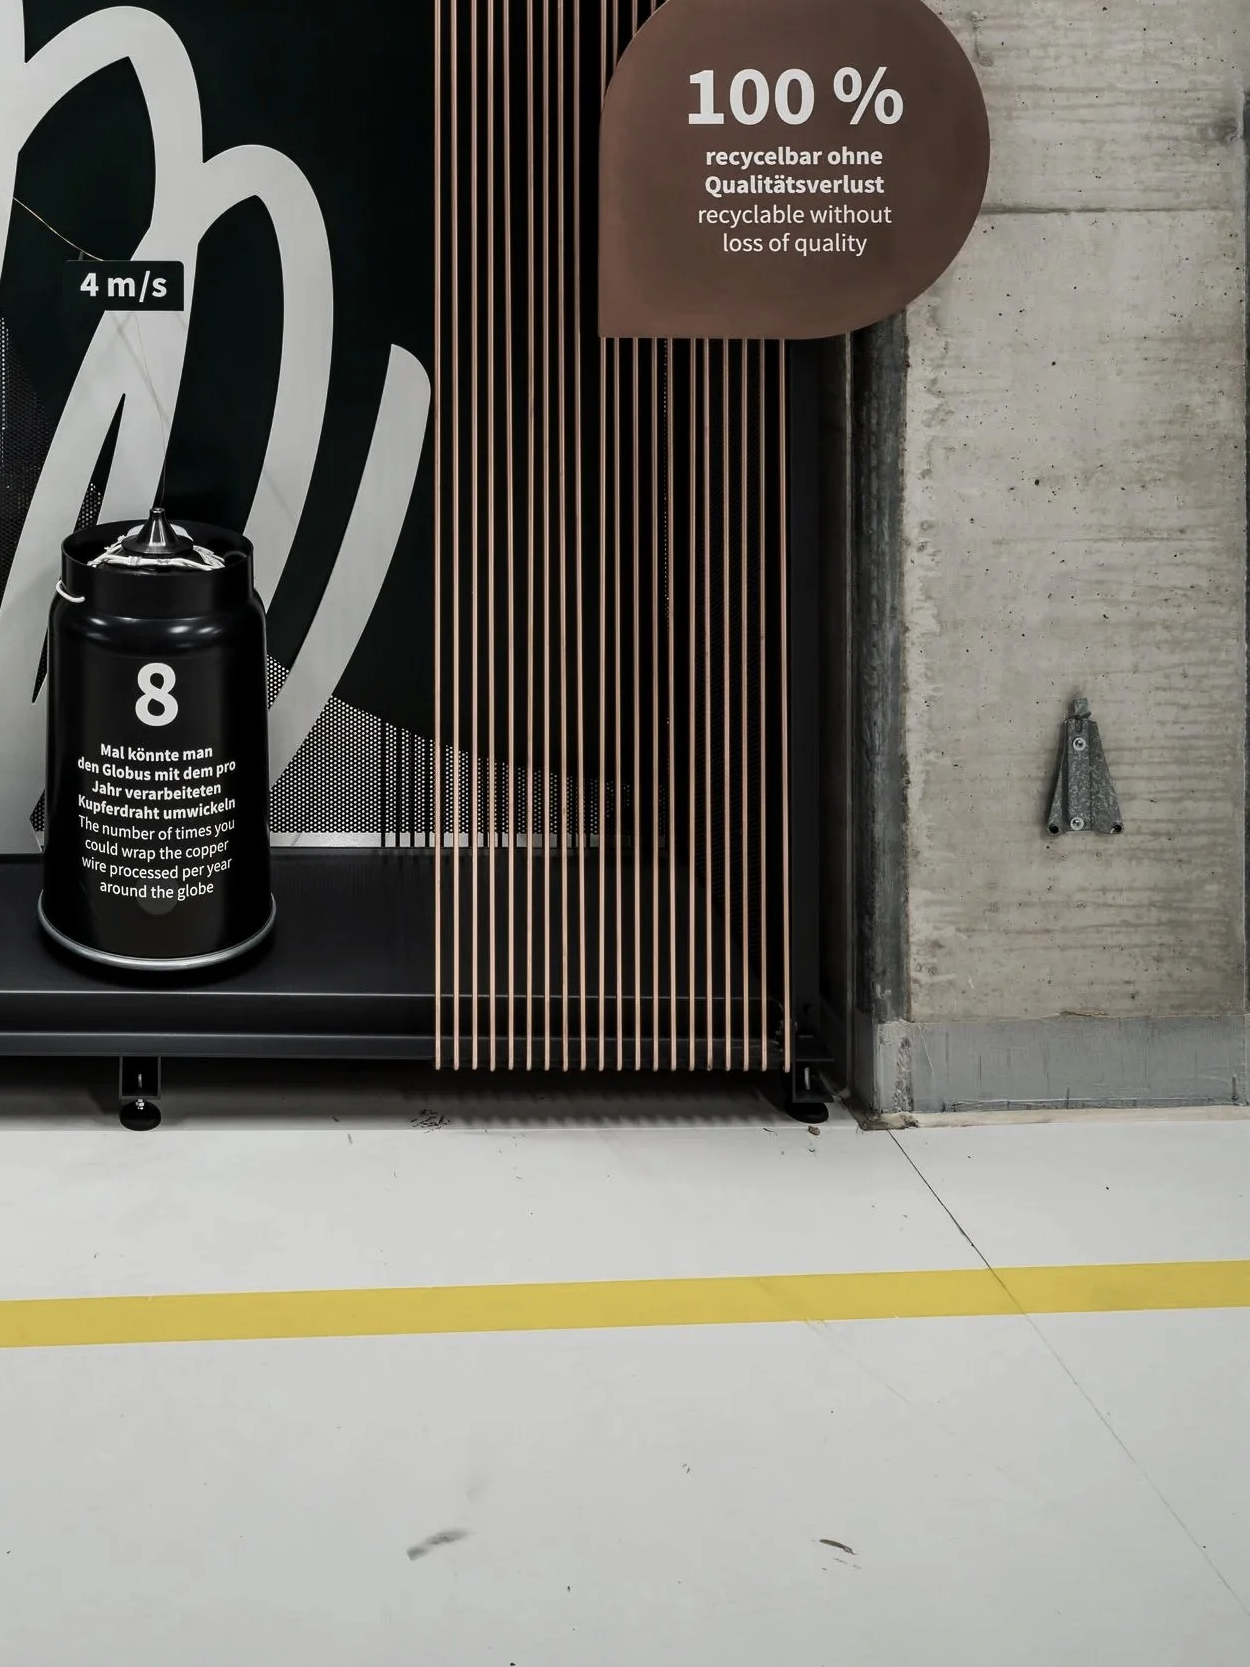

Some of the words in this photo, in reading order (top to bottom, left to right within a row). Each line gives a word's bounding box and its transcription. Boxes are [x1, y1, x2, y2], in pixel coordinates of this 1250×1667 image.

[688, 68, 815, 126] 100
[833, 66, 904, 125] %
[706, 146, 823, 171] recycelbar
[827, 146, 883, 166] ohne
[704, 175, 885, 199] Qualitätsverlust
[698, 204, 805, 229] recyclable
[809, 204, 892, 224] without
[723, 233, 764, 253] loss
[768, 233, 791, 253] of
[794, 233, 868, 257] quality
[80, 272, 100, 297] 4
[107, 270, 167, 303] m/s
[134, 662, 179, 727] 8
[100, 743, 125, 760] Mal
[128, 747, 180, 762] könnte
[183, 747, 213, 761] man
[77, 756, 99, 774] den
[102, 764, 151, 781] Globus
[154, 767, 180, 781] mit
[183, 766, 213, 780] dem
[216, 760, 236, 778] pro
[92, 780, 122, 797] Jahr
[124, 783, 222, 800] verarbeiteten
[78, 794, 160, 820] Kupferdraht
[163, 797, 236, 820] umwickeln
[78, 814, 99, 833] The
[102, 824, 155, 840] number
[158, 827, 173, 840] of
[175, 824, 212, 840] times
[214, 819, 235, 837] you
[85, 839, 118, 856] could
[121, 847, 156, 863] wrap
[159, 846, 182, 860] the
[185, 840, 229, 860] copper
[81, 856, 107, 873] wire
[109, 865, 179, 880] processed
[182, 865, 204, 881] per
[206, 858, 233, 877] year
[100, 881, 147, 899] around
[150, 885, 174, 899] the
[177, 882, 214, 901] globe
